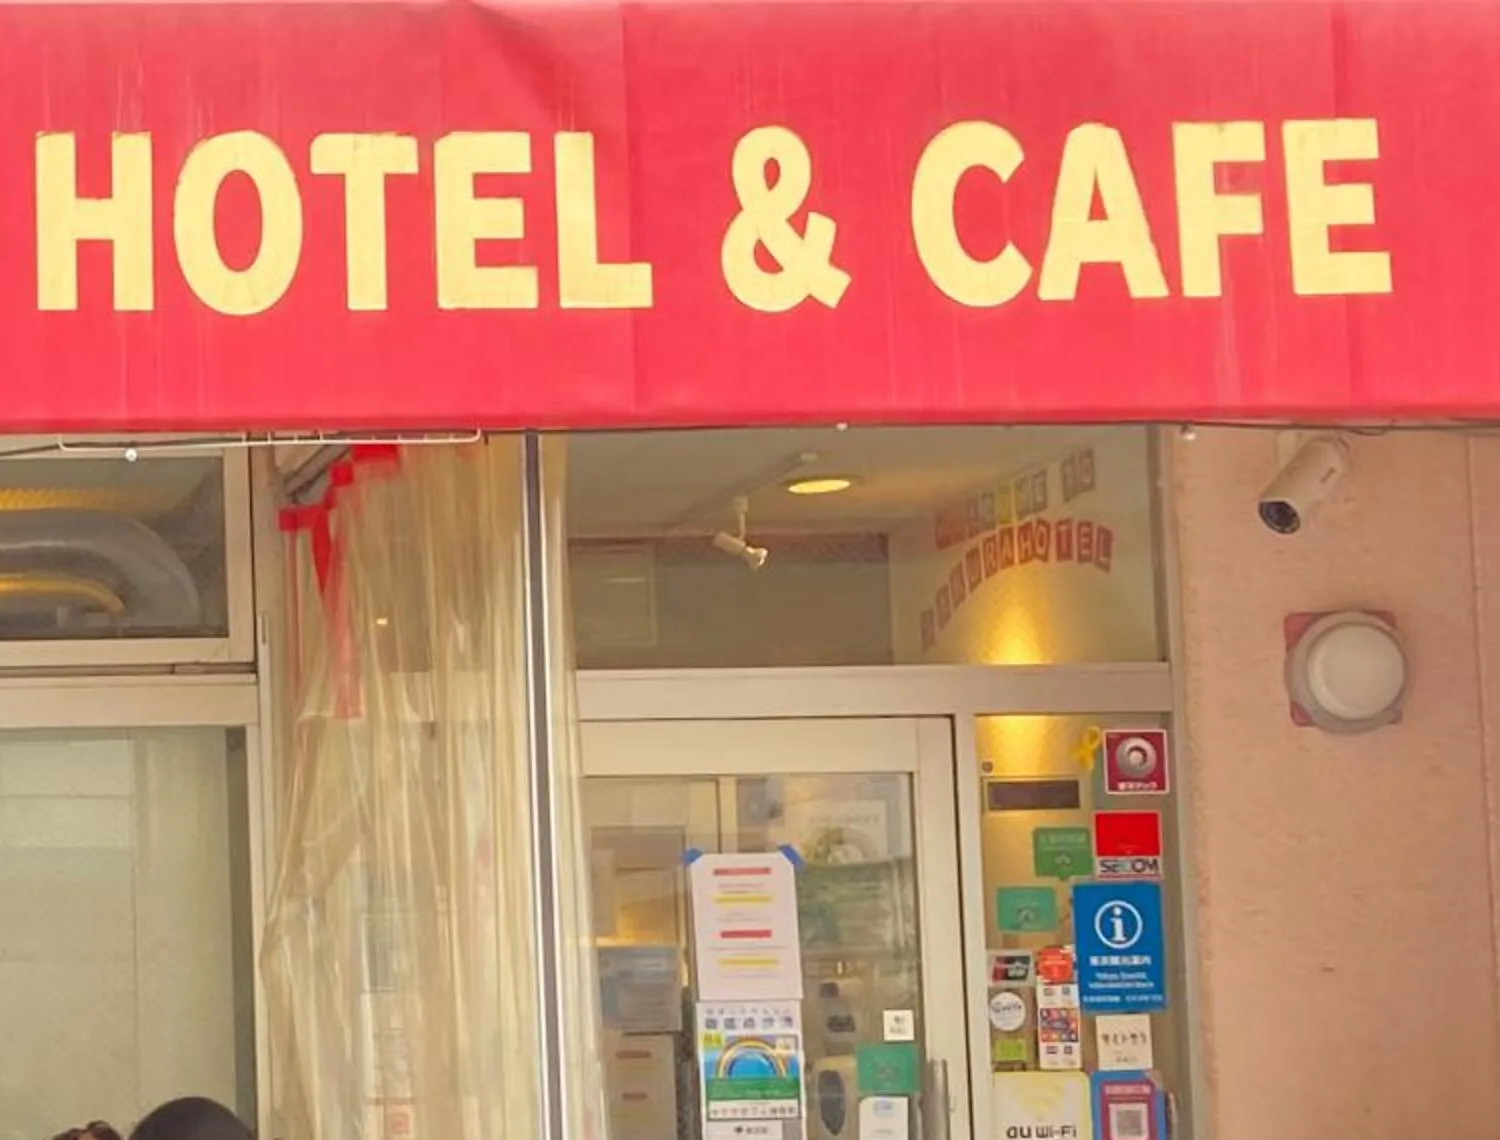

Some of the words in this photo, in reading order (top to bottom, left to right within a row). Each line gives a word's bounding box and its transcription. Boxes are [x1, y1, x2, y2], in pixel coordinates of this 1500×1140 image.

[35, 130, 653, 315] HOTEL
[721, 125, 851, 312] &
[911, 118, 1392, 307] CAFE
[1018, 522, 1111, 566] HOTEL
[1006, 1125, 1032, 1138] au
